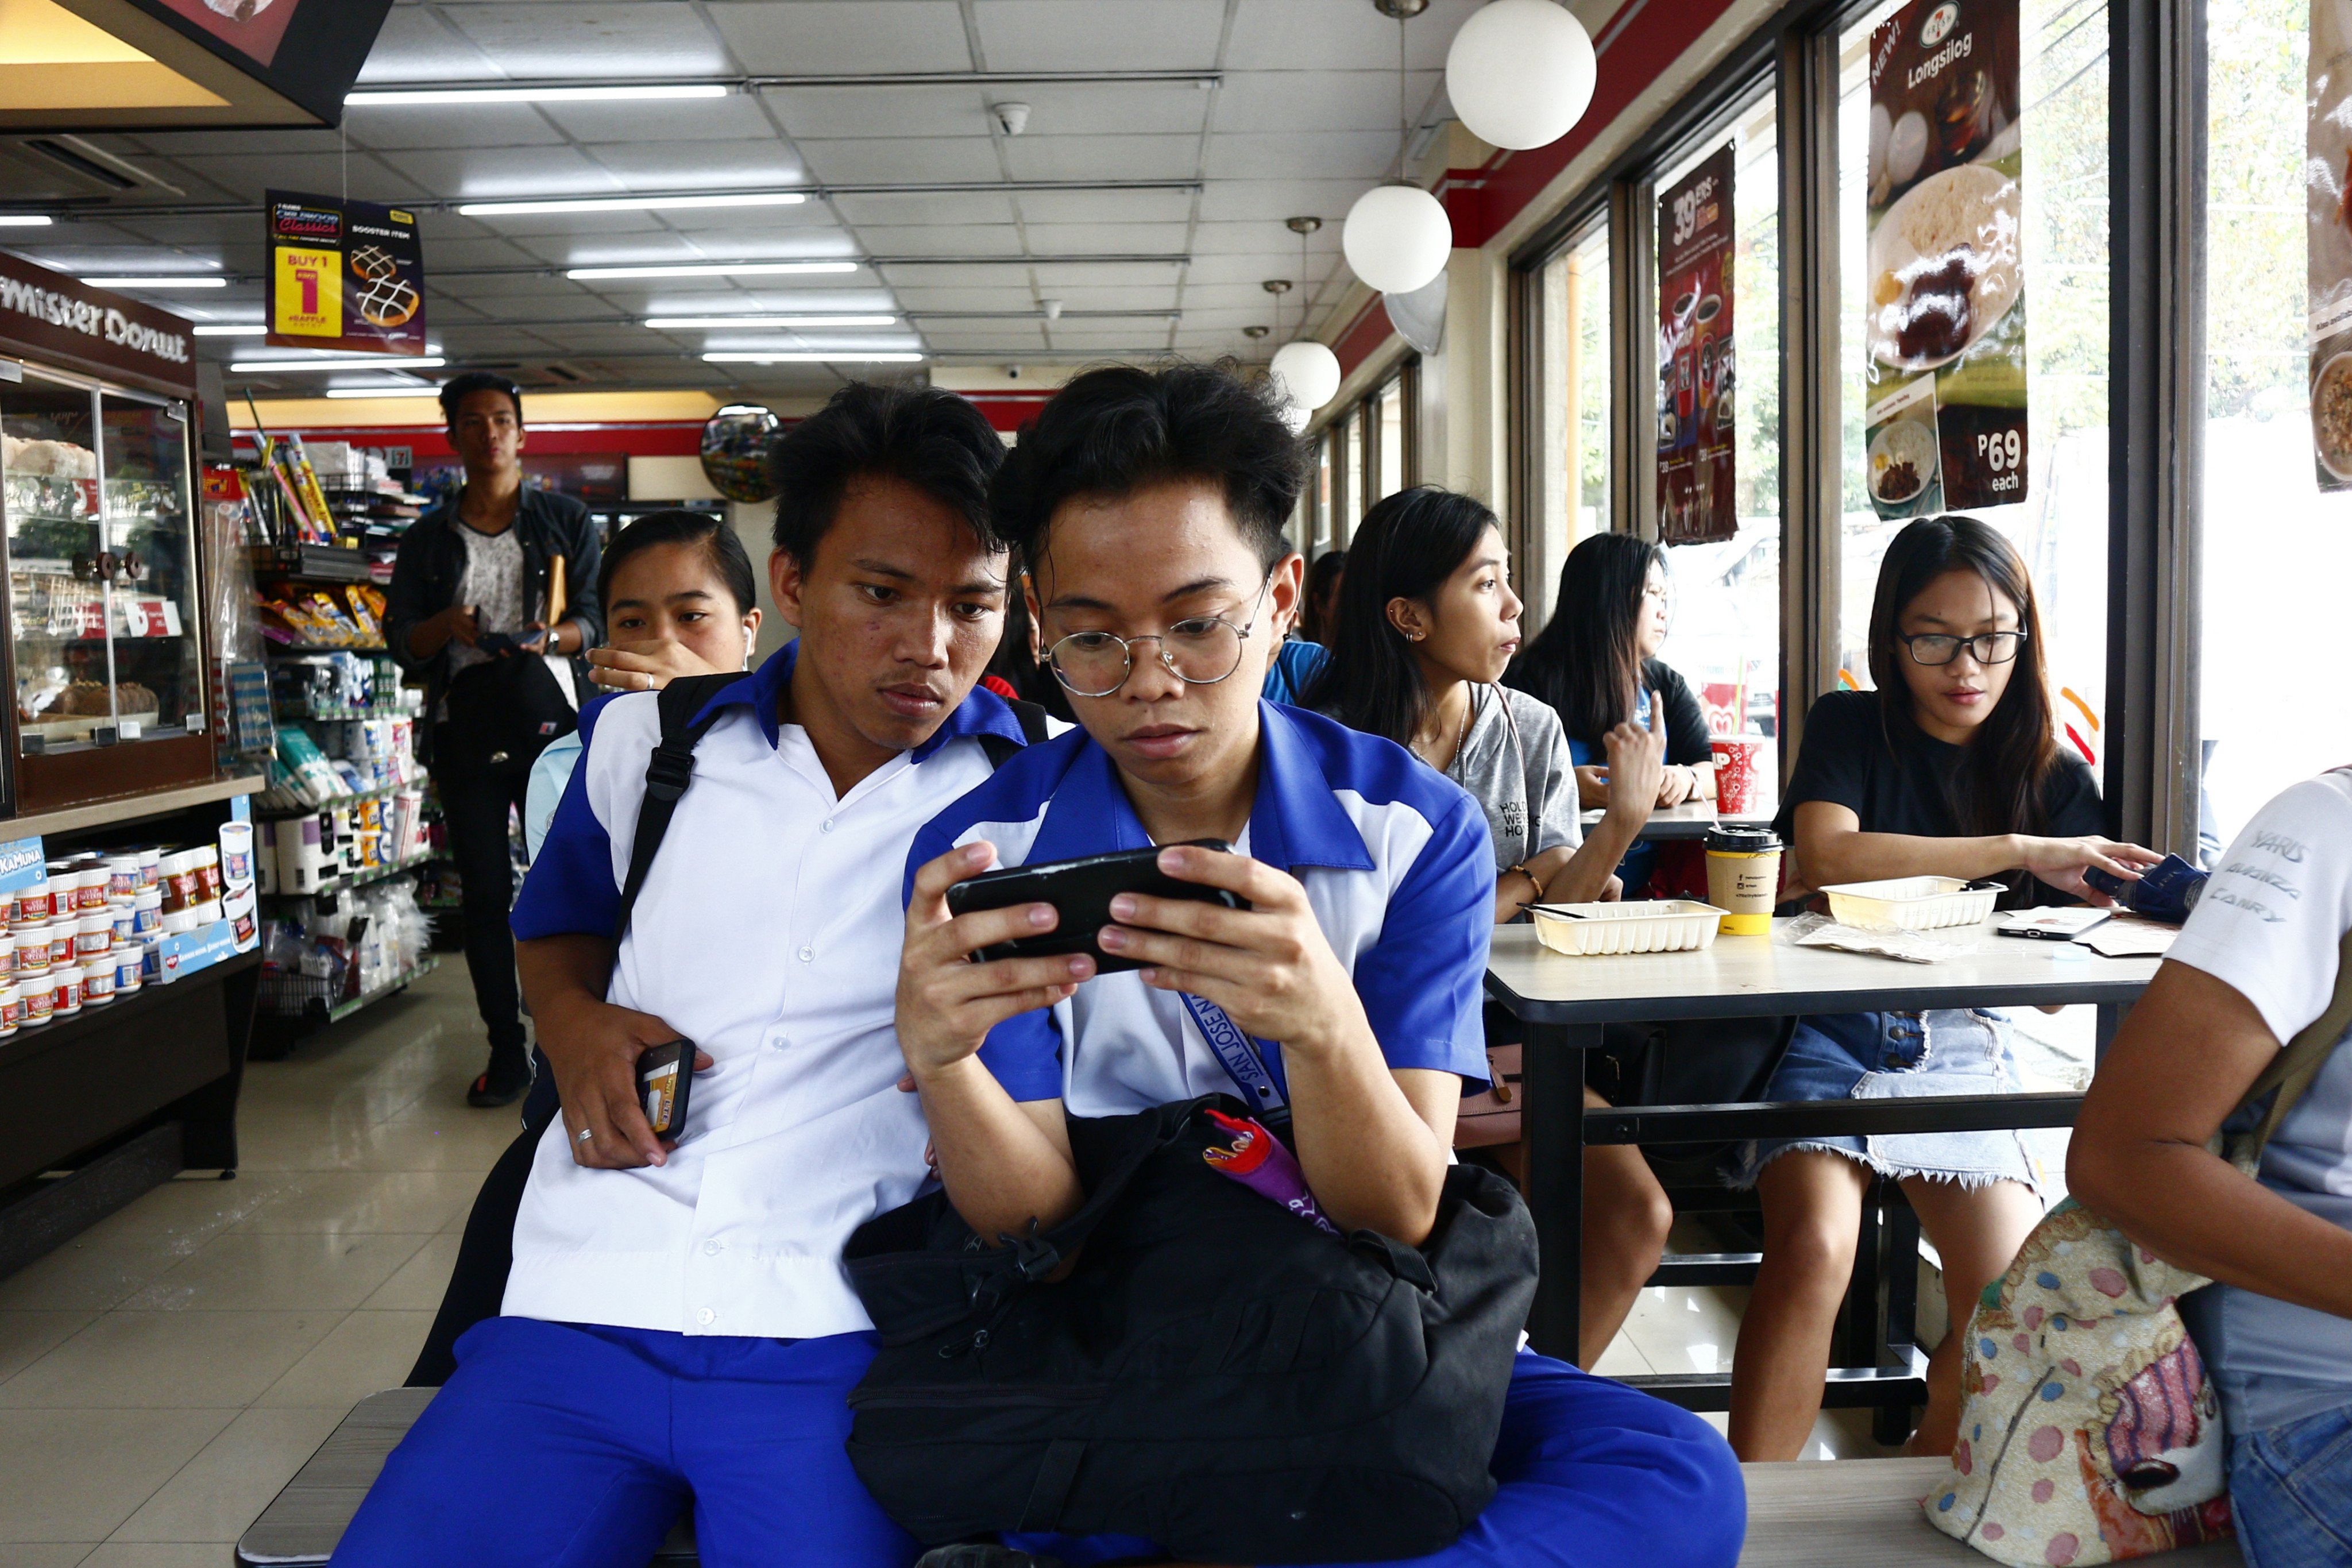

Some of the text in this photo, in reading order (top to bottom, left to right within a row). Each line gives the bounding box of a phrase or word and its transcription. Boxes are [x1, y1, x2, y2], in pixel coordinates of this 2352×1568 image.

[1871, 19, 1901, 84] NEW!
[1907, 32, 1972, 90] Longsilog
[279, 217, 337, 233] Classics
[352, 224, 411, 240] BOOSTER ITEM
[288, 255, 327, 267] BUY 1
[295, 269, 318, 314] 1
[2, 279, 190, 364] Mister Donut
[1992, 471, 2019, 492] each
[1500, 801, 1528, 814] HOLD
[2251, 831, 2310, 863] YARIS
[1204, 1013, 1240, 1051] JOSE
[1228, 1052, 1260, 1081] SAN
[661, 1099, 671, 1124] LTE
